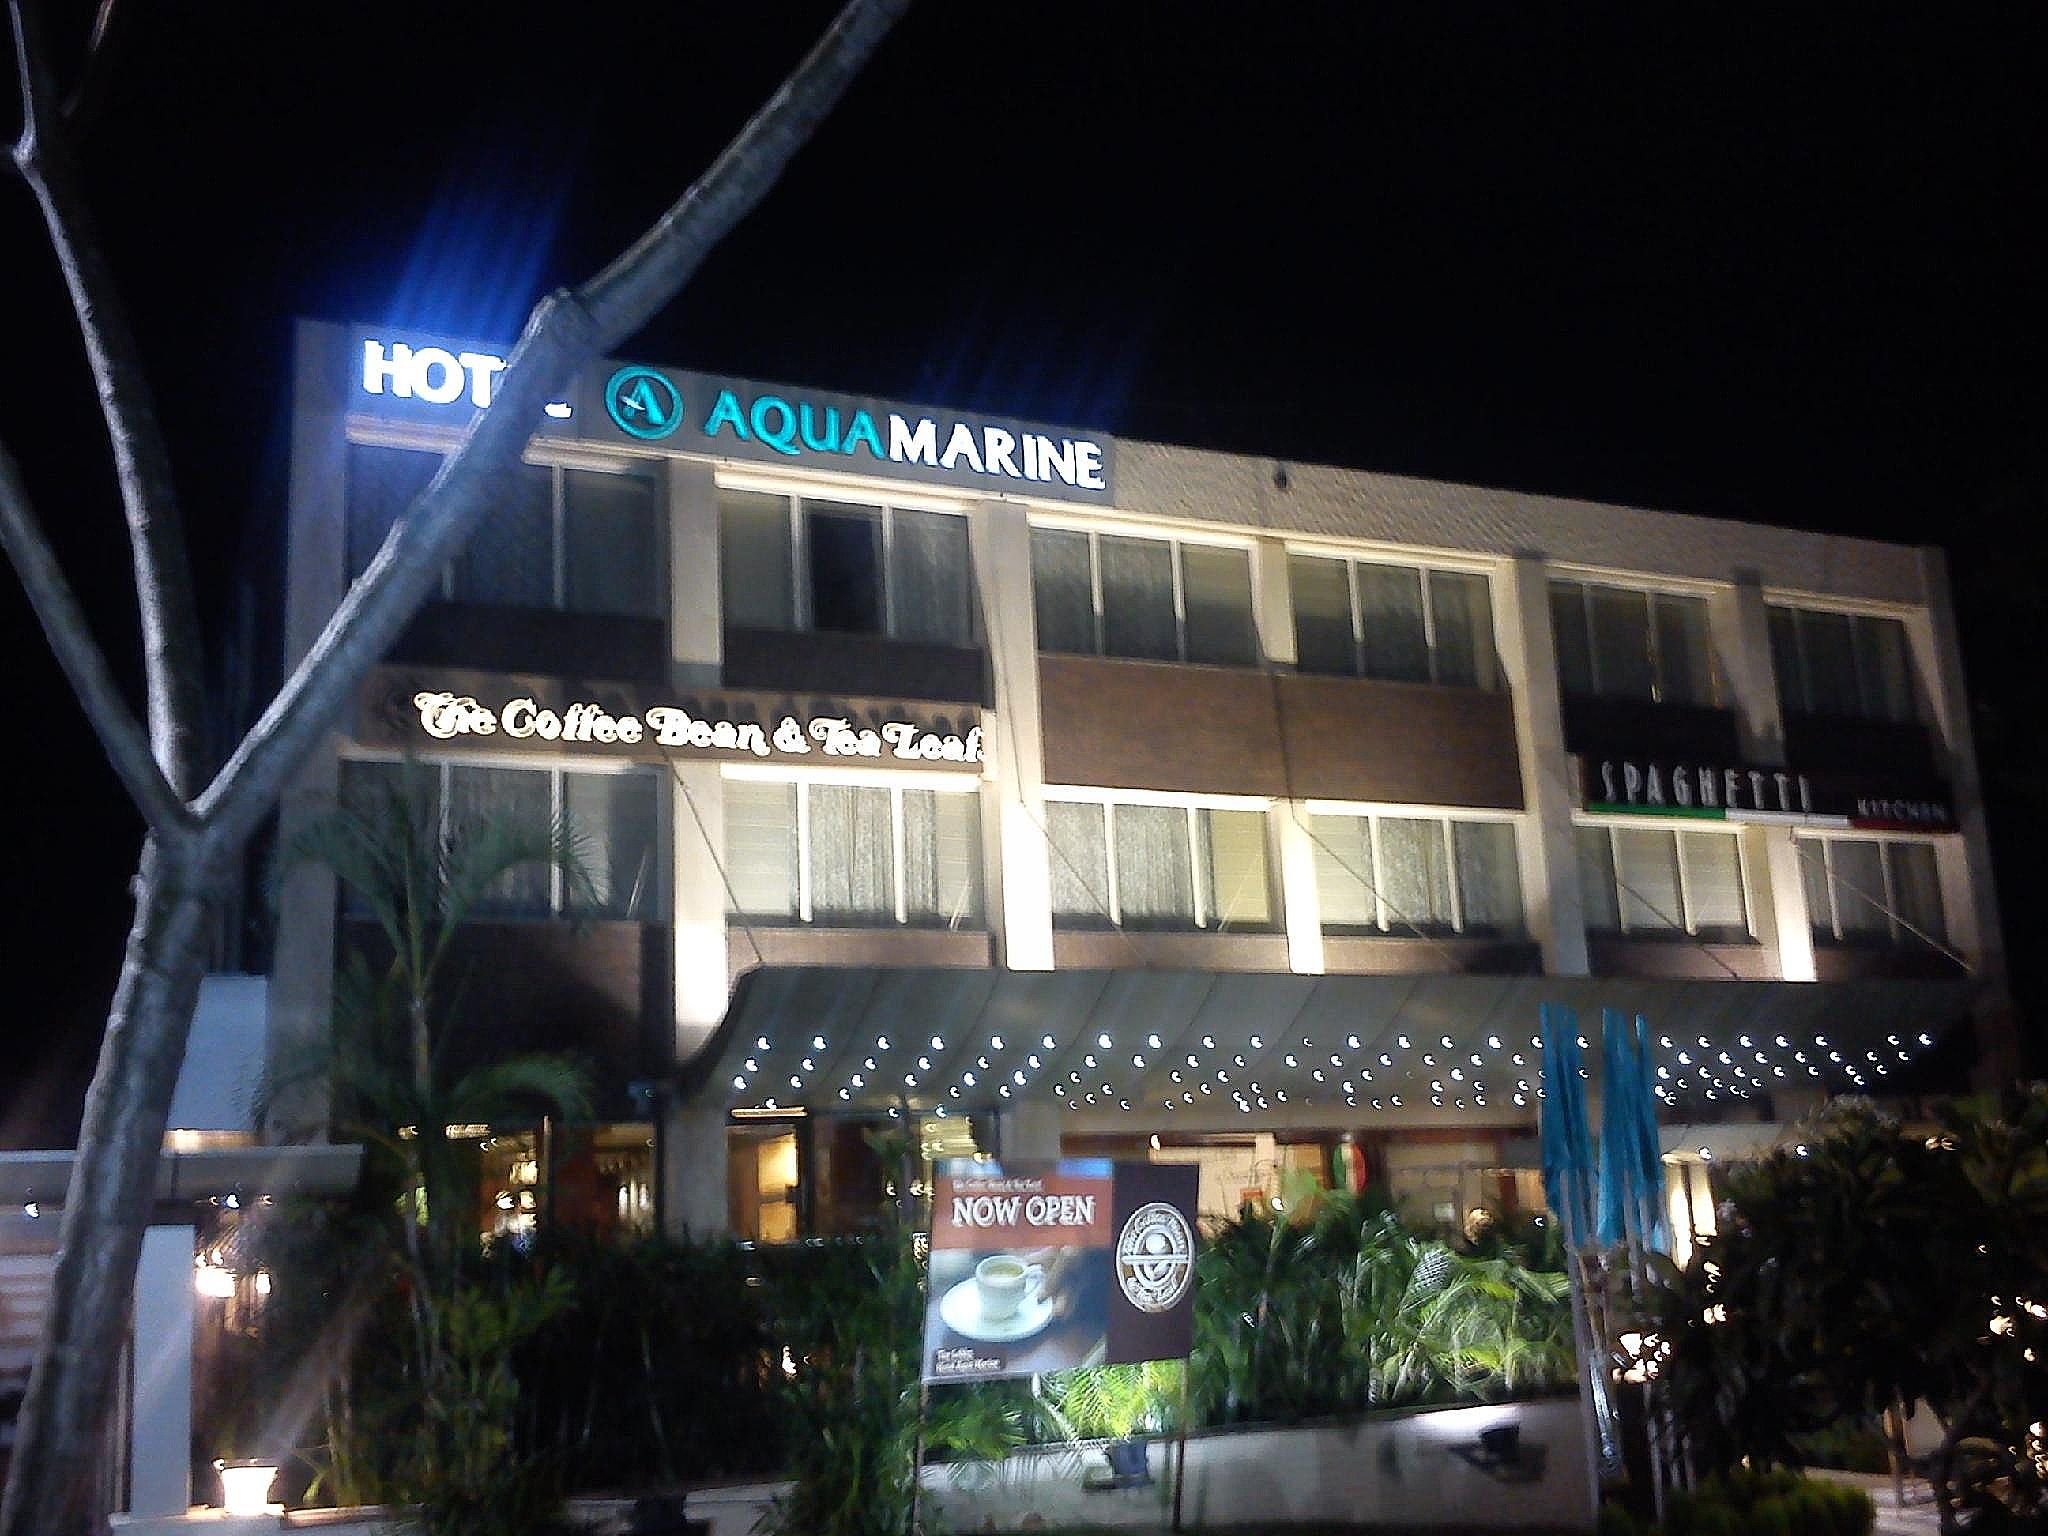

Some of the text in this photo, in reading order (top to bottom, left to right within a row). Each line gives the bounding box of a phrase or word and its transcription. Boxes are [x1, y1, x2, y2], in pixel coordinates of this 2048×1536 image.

[363, 339, 573, 418] HOT
[704, 389, 1106, 490] AQUAMARINE
[413, 691, 498, 739] The
[501, 698, 643, 744] Coffee
[646, 706, 771, 757] Bean
[772, 716, 811, 754] &
[808, 717, 881, 757] Tea
[1601, 760, 1811, 812] SPAGHETTI
[952, 1195, 1095, 1227] NOW OPEN
